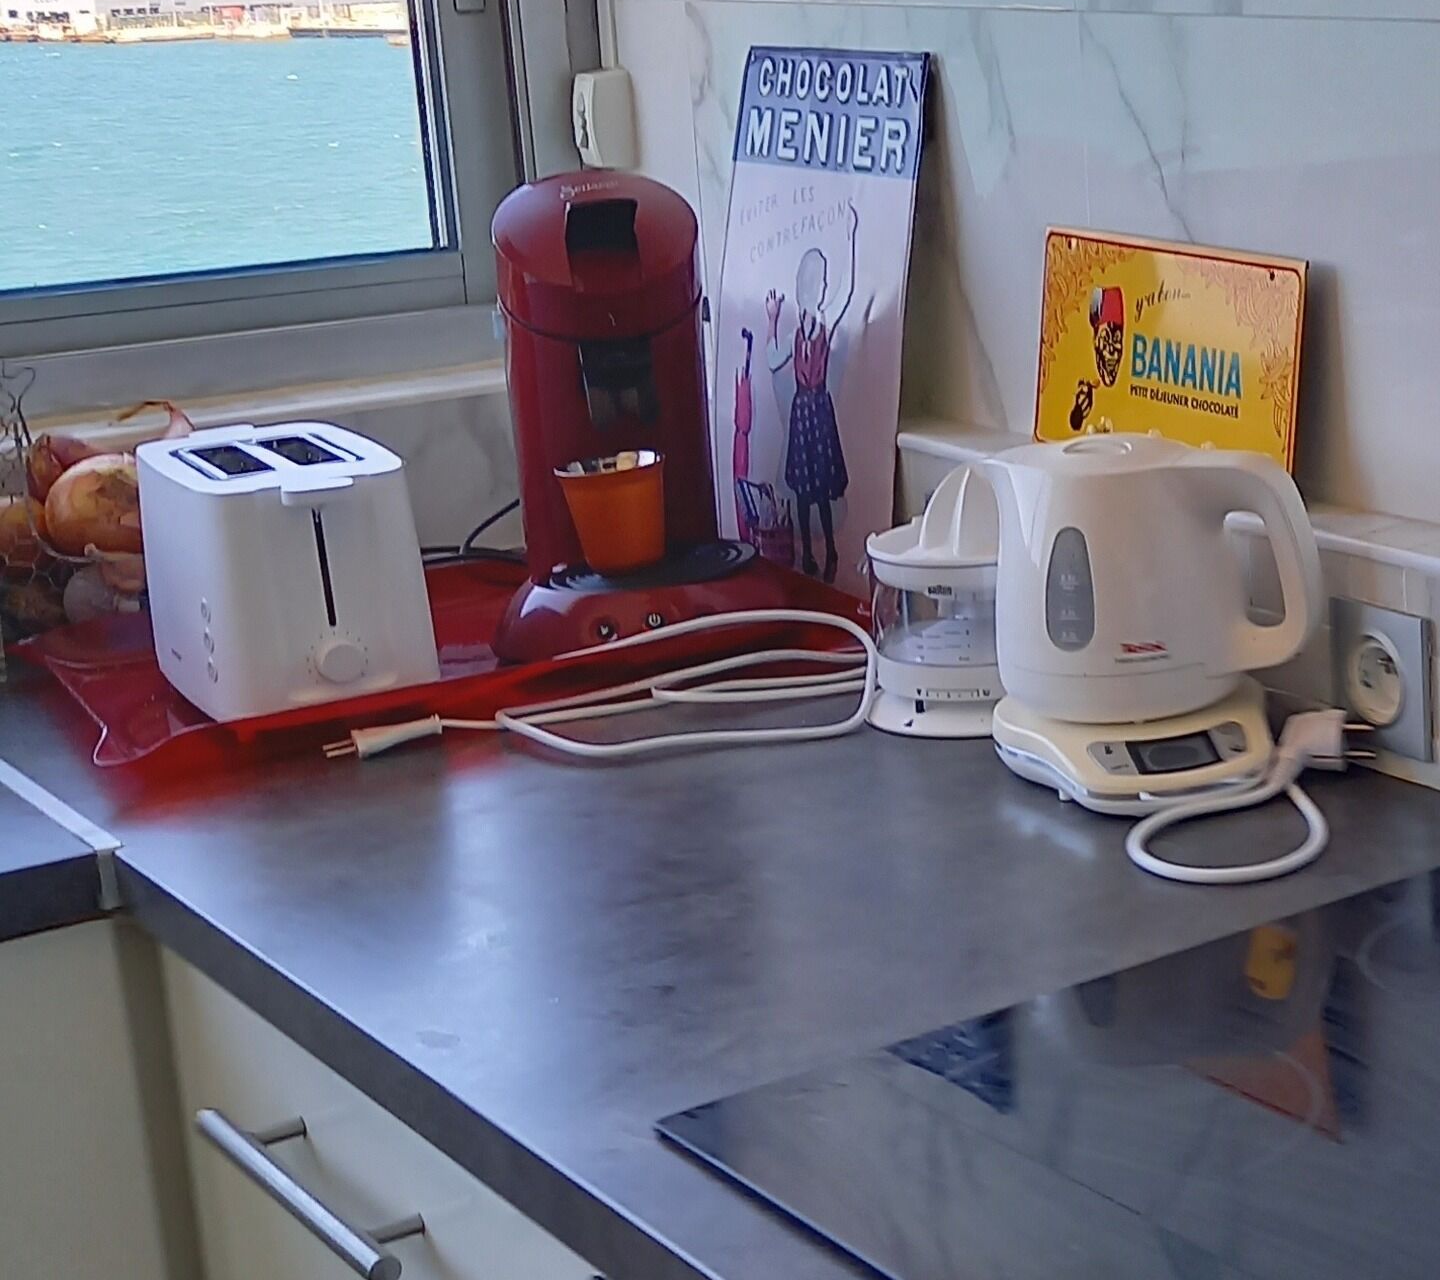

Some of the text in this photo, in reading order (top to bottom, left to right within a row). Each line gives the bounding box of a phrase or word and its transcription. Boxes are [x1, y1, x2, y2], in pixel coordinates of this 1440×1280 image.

[758, 55, 910, 108] CHOCOLAT
[744, 106, 910, 174] MENIER
[1131, 331, 1242, 400] BANANIA
